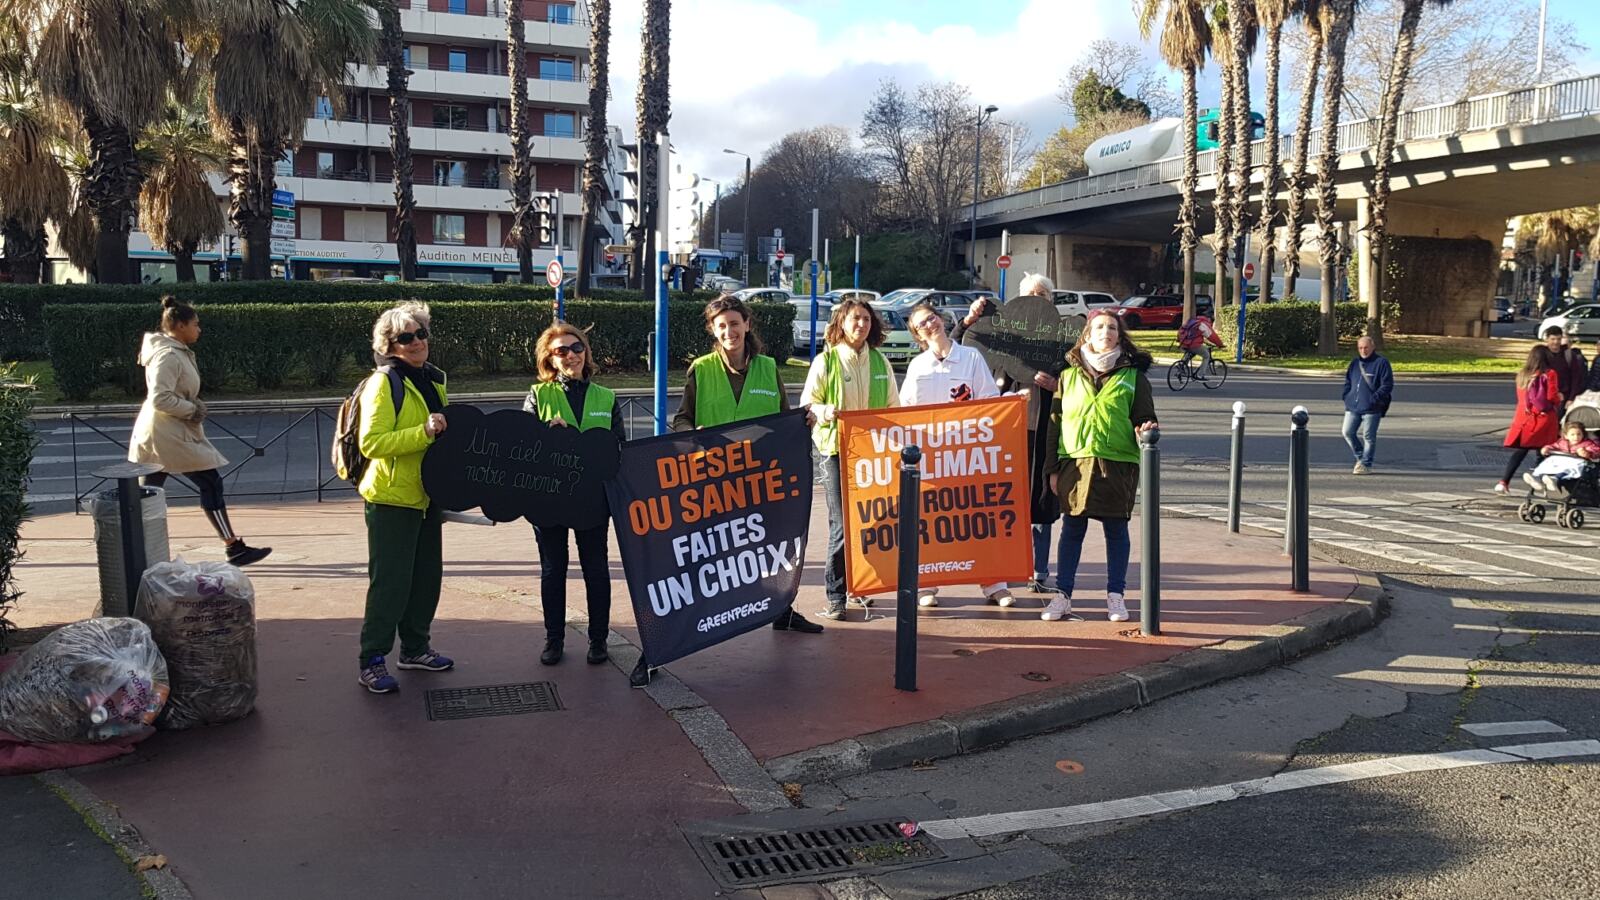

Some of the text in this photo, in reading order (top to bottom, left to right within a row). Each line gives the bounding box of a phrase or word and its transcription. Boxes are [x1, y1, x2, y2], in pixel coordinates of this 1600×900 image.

[419, 250, 520, 263] Audition MEINEL
[991, 312, 1007, 328] On
[463, 427, 500, 458] Un
[507, 438, 542, 464] ciel
[465, 460, 507, 488] notre
[854, 456, 893, 489] OU
[627, 494, 673, 537] OU
[856, 481, 1015, 524] VOU ROULEZ
[918, 559, 976, 575] EENPEACE
[646, 572, 695, 618] UN
[696, 597, 772, 633] GREENPEACE
